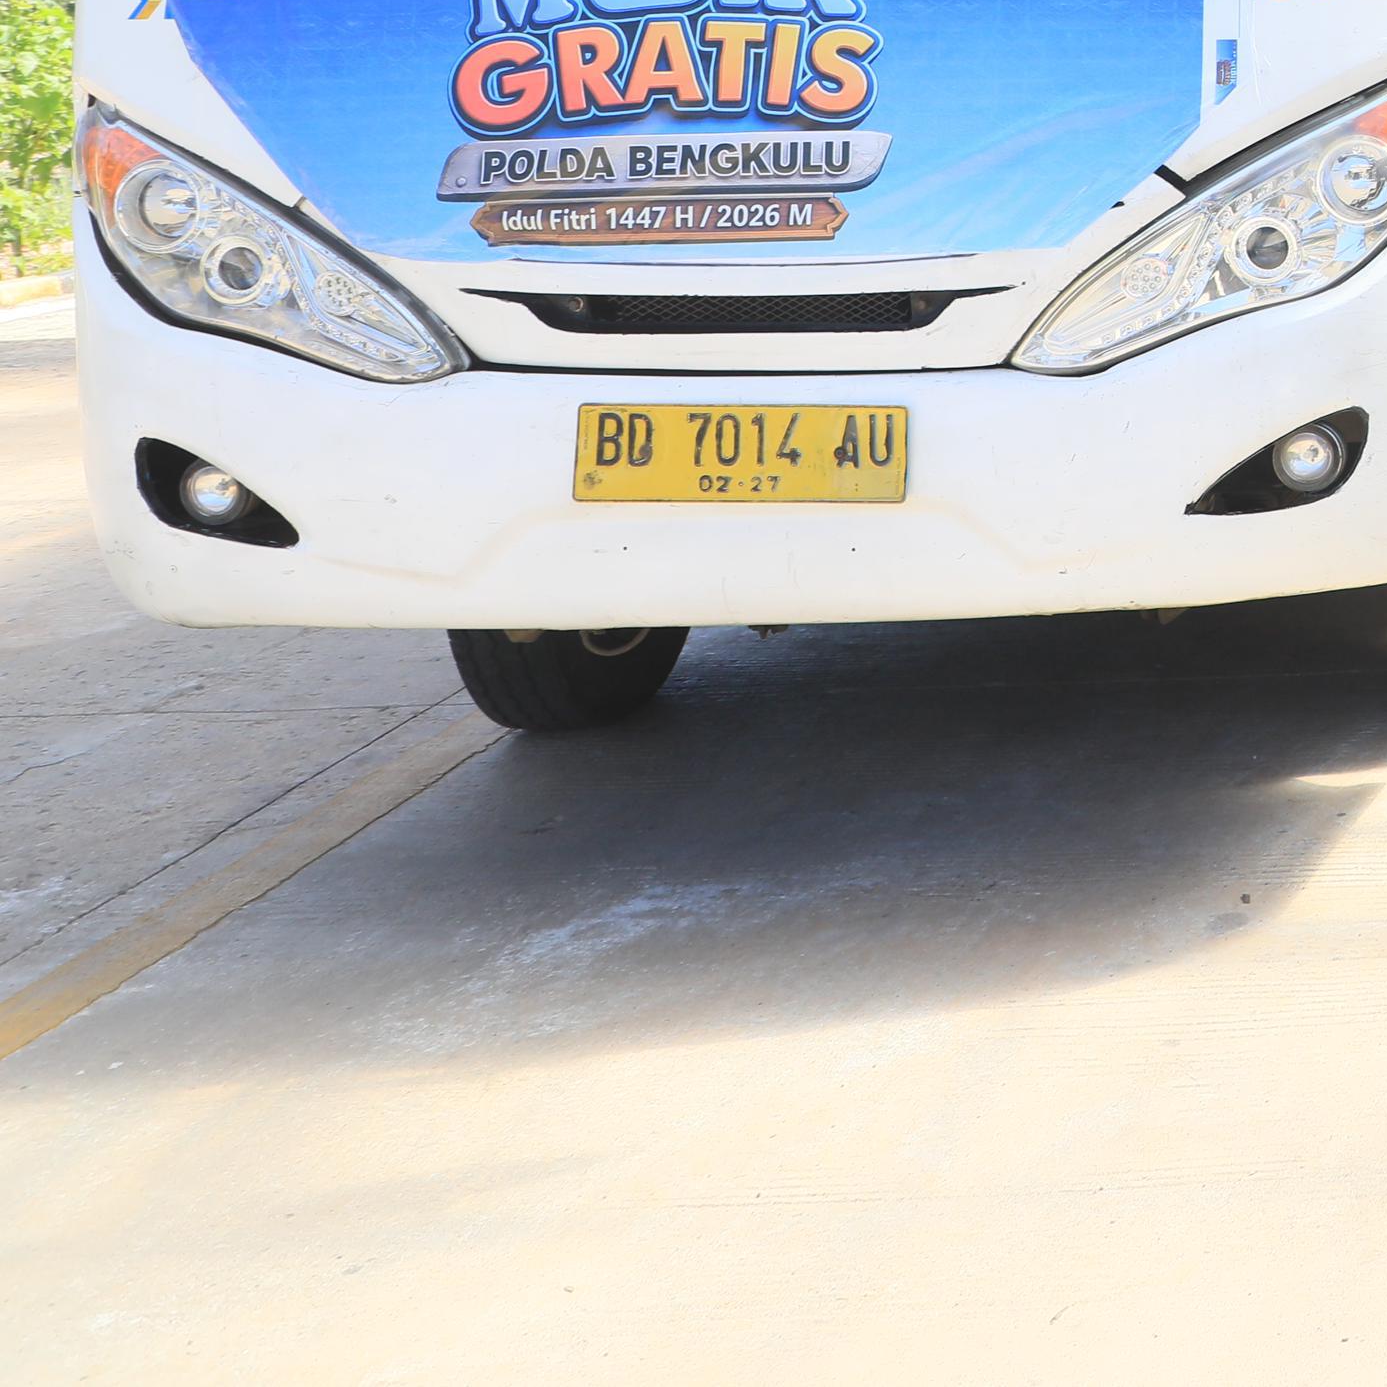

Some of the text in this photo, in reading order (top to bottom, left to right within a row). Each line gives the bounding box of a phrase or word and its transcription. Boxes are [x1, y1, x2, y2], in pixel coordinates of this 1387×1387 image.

[452, 17, 880, 130] GRATIS
[480, 140, 852, 184] POLDA BENGKULU
[502, 210, 543, 231] Idul
[550, 208, 597, 230] Fitri
[606, 205, 662, 229] 1447
[675, 205, 694, 228] H
[720, 205, 780, 228] 2026
[788, 204, 813, 226] M
[596, 413, 894, 468] BD 7014 AU
